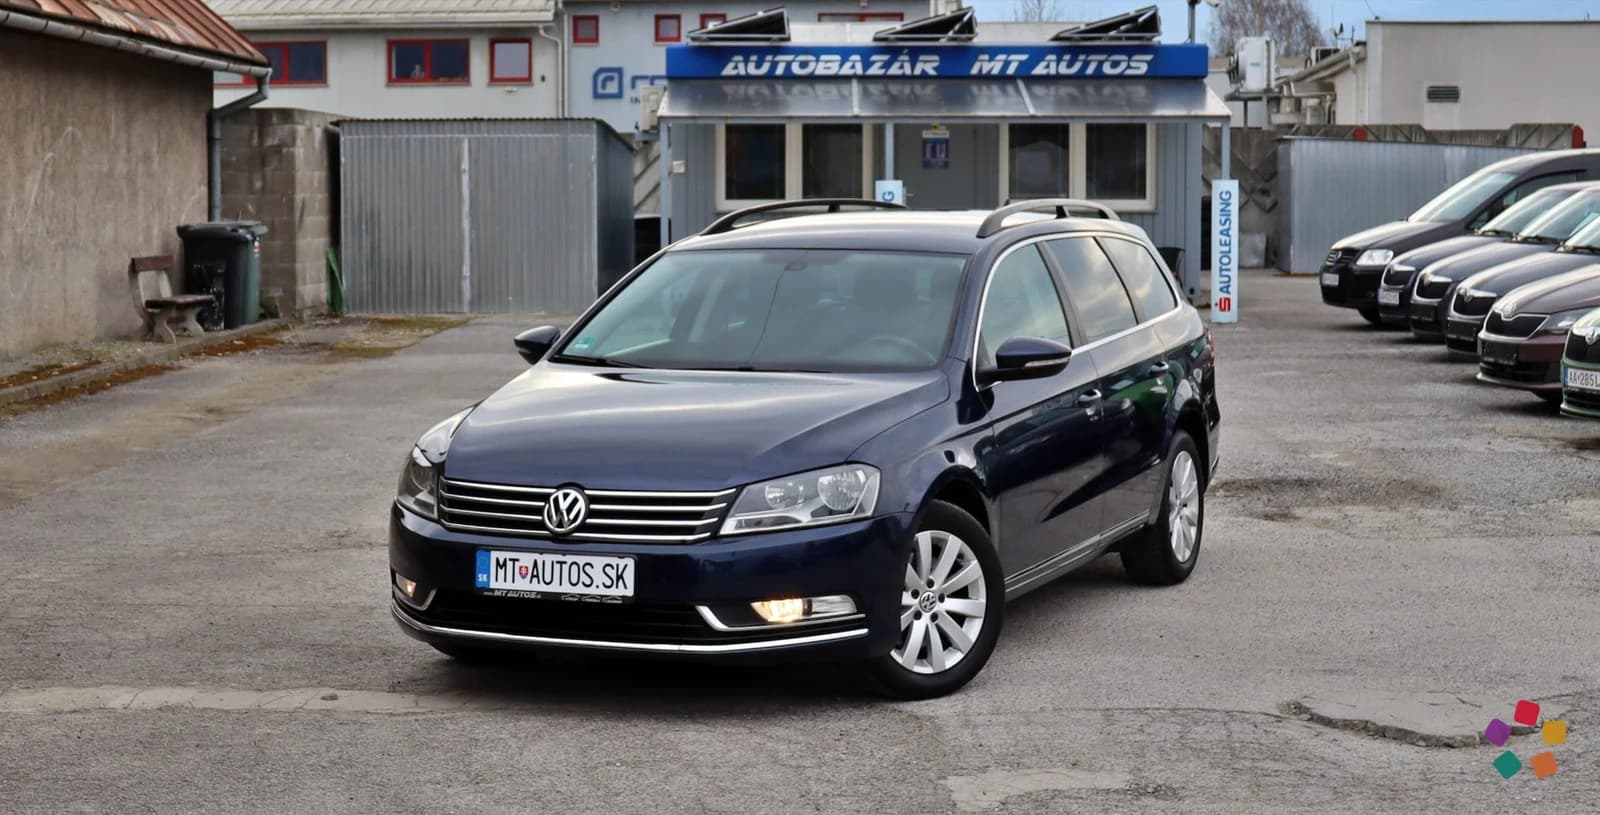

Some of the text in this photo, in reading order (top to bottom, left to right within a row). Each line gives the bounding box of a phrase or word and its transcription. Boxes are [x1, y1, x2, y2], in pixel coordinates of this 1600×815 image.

[720, 49, 1154, 76] AUTOBAZÁR MT AUTOS
[1219, 191, 1231, 294] AUTOLEASING
[495, 557, 628, 590] MT AUTOS.SK
